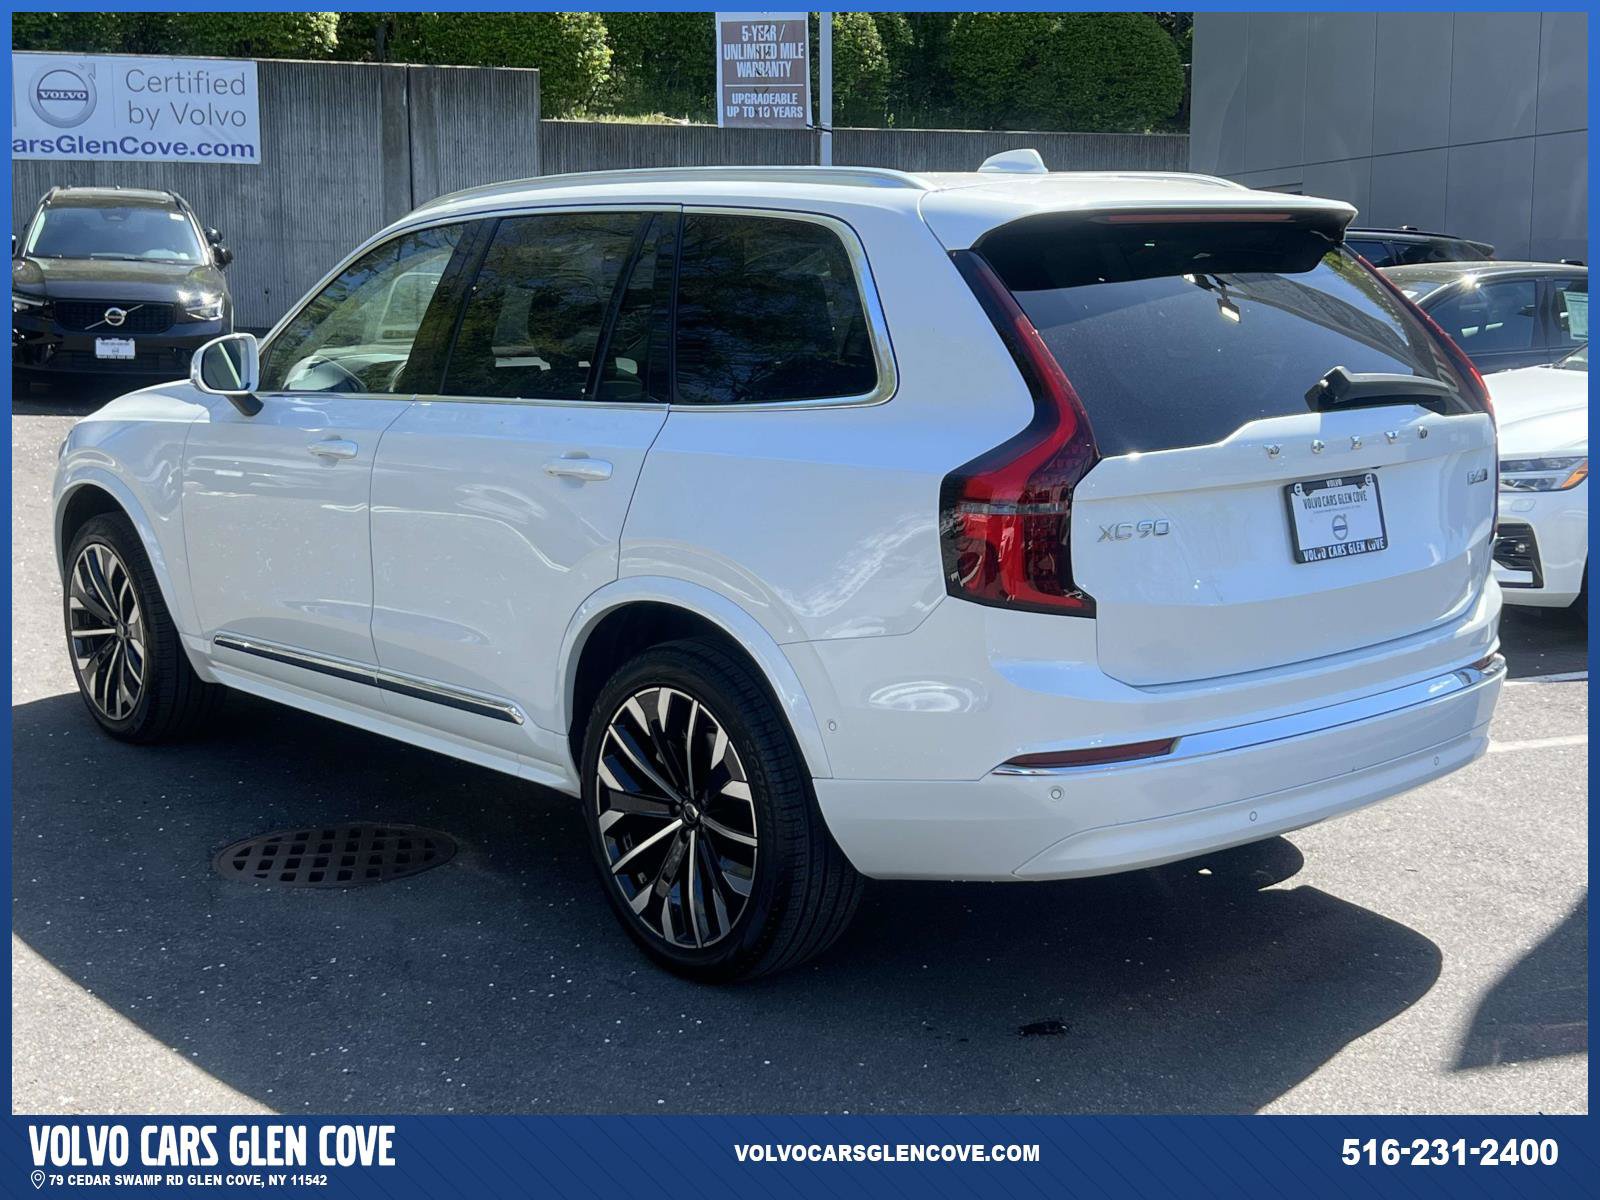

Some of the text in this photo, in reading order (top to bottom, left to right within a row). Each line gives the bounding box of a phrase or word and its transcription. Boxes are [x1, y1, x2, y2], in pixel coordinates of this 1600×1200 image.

[742, 25, 776, 41] 5-YEAR
[724, 42, 804, 60] UNLIMITED MILE
[737, 61, 792, 77] WARRANTY
[126, 69, 245, 96] Certified
[39, 91, 87, 100] VOLVO
[732, 93, 798, 105] UPGRADEABLE
[129, 101, 247, 130] by Volvo
[727, 106, 803, 118] UP TO 10 YEARS
[12, 135, 255, 158] arsGlenCove.com
[1326, 478, 1343, 488] VOLVO
[1303, 490, 1367, 509] VOLVO CARS GLEN COVE
[1304, 547, 1326, 561] VOLVO
[1328, 544, 1347, 557] CARS
[1348, 541, 1366, 553] GLEN
